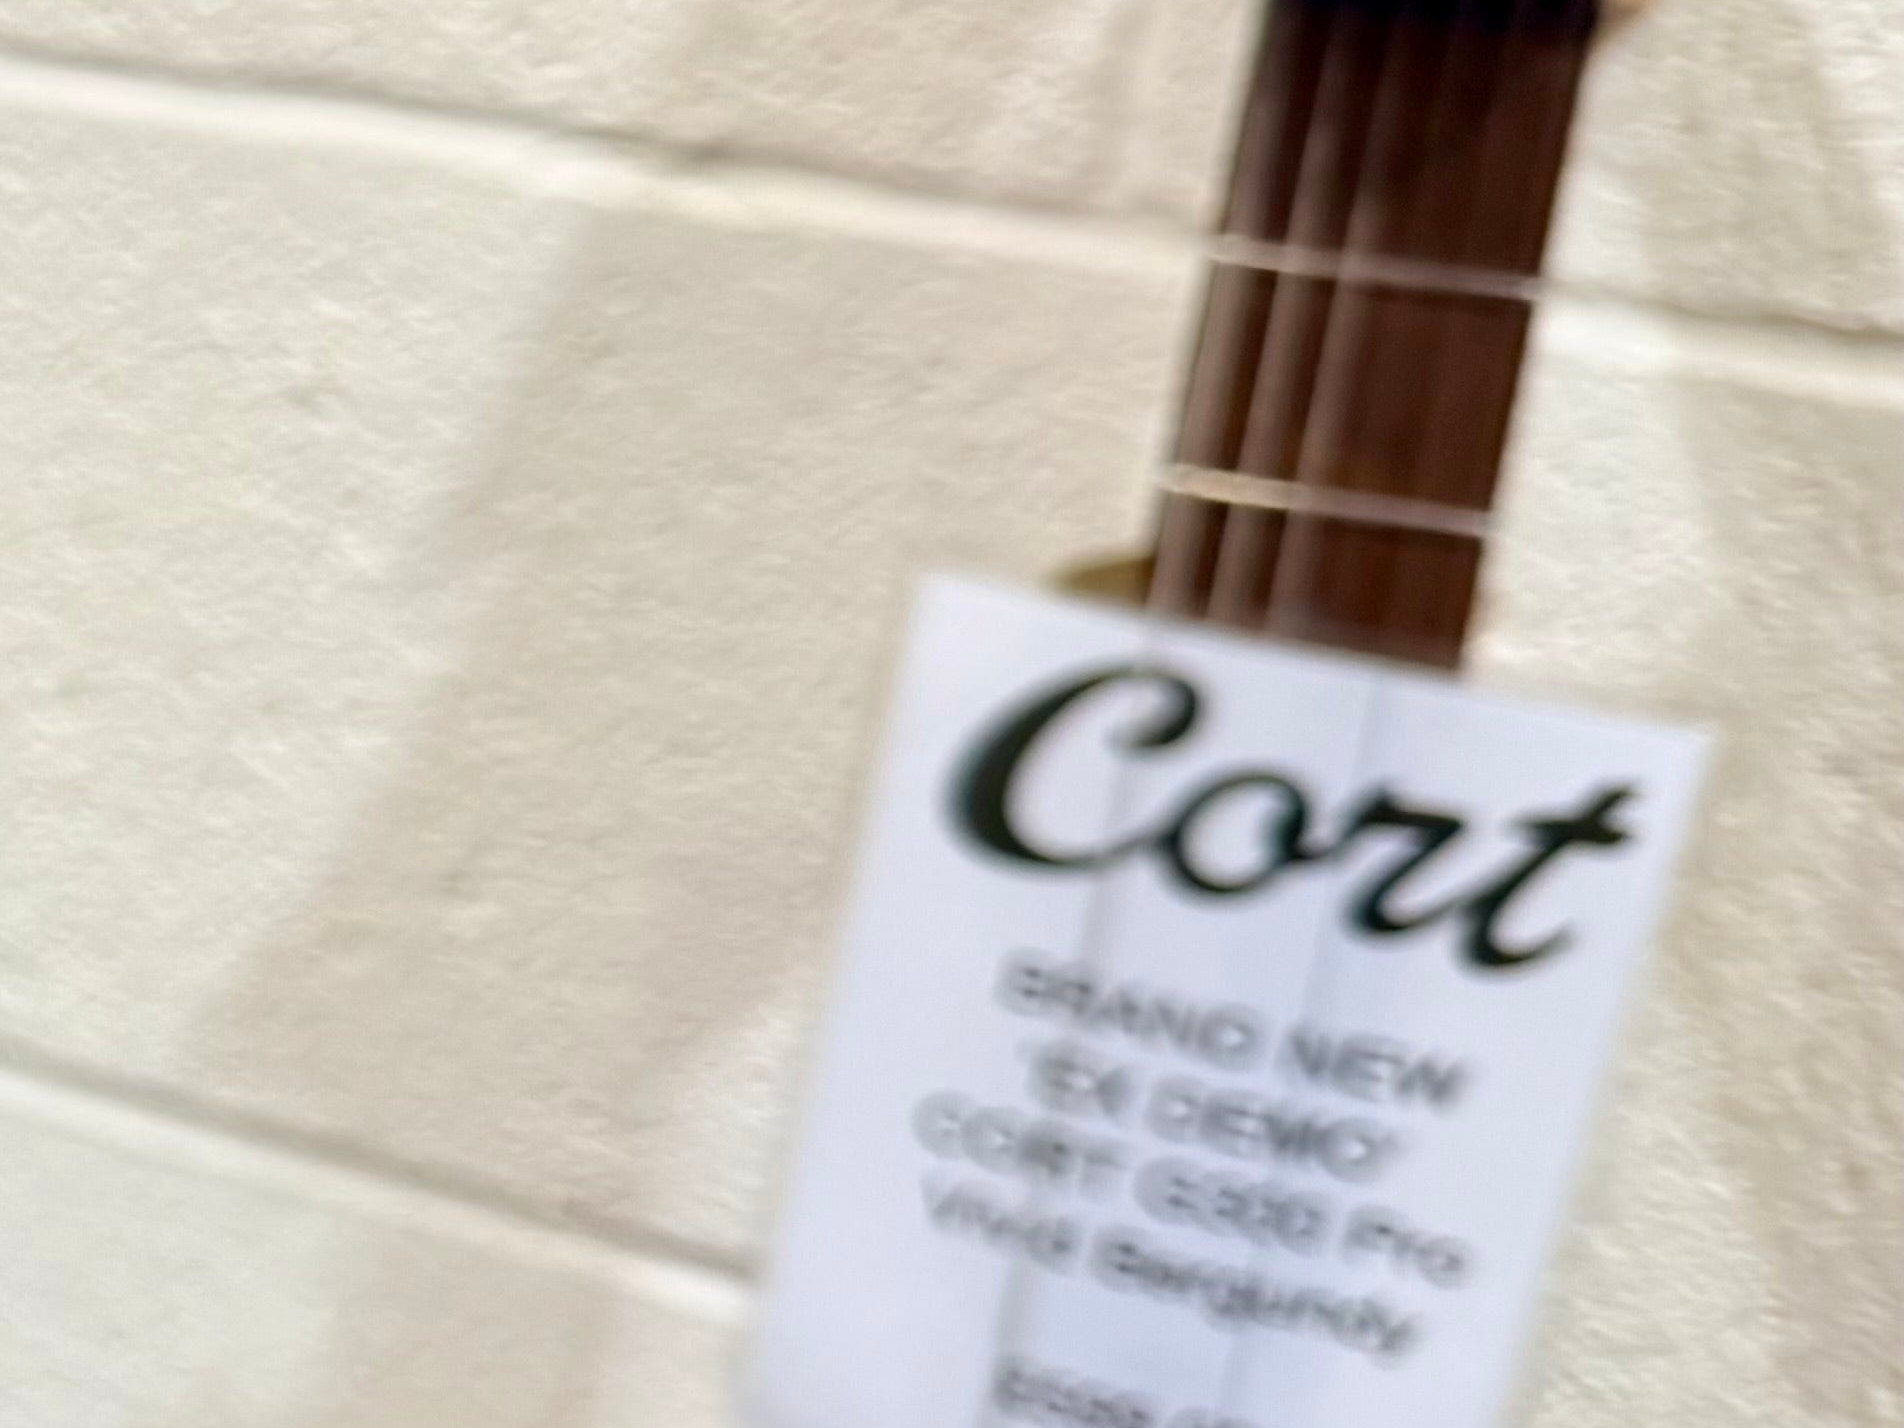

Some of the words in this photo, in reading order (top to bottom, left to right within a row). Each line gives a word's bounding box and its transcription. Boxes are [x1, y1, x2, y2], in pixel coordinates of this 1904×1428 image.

[943, 658, 1648, 981] Cort
[997, 950, 1264, 1069] BRAND
[1275, 1016, 1470, 1112] NEW
[909, 1089, 1134, 1197] CORT
